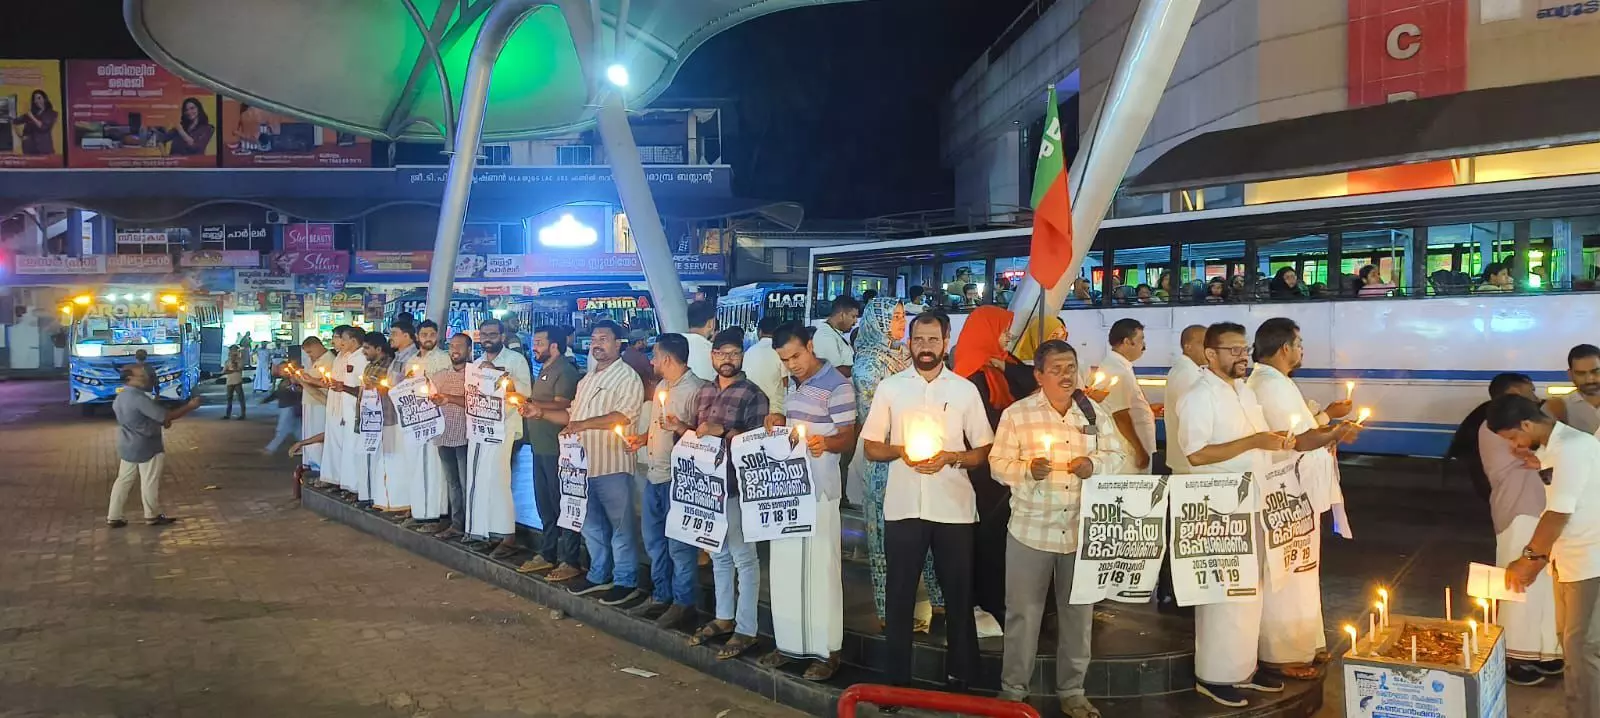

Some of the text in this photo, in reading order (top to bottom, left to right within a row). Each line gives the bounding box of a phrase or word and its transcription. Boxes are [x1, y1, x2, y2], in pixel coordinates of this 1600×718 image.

[1386, 23, 1421, 60] C
[684, 262, 718, 270] SERVICE
[577, 296, 650, 310] FATHIMA
[677, 457, 697, 477] SDPI
[741, 450, 768, 470] SDPI
[744, 462, 805, 485] ജനകീയ
[676, 473, 723, 498] ജനകീയ
[757, 502, 771, 511] 2025
[1265, 489, 1289, 512] SDPI
[760, 508, 798, 524] 17 18 19
[1091, 503, 1121, 522] SDPI
[1181, 502, 1208, 521] SDPI
[681, 514, 714, 533] 17 18 19
[1089, 518, 1159, 542] ജനകീയ
[1180, 514, 1247, 539] ജനകീയ
[1302, 546, 1310, 560] 19
[1192, 559, 1207, 569] 2025
[1098, 570, 1141, 585] 17 18 19
[1195, 570, 1207, 585] 17
[1226, 569, 1239, 582] 19
